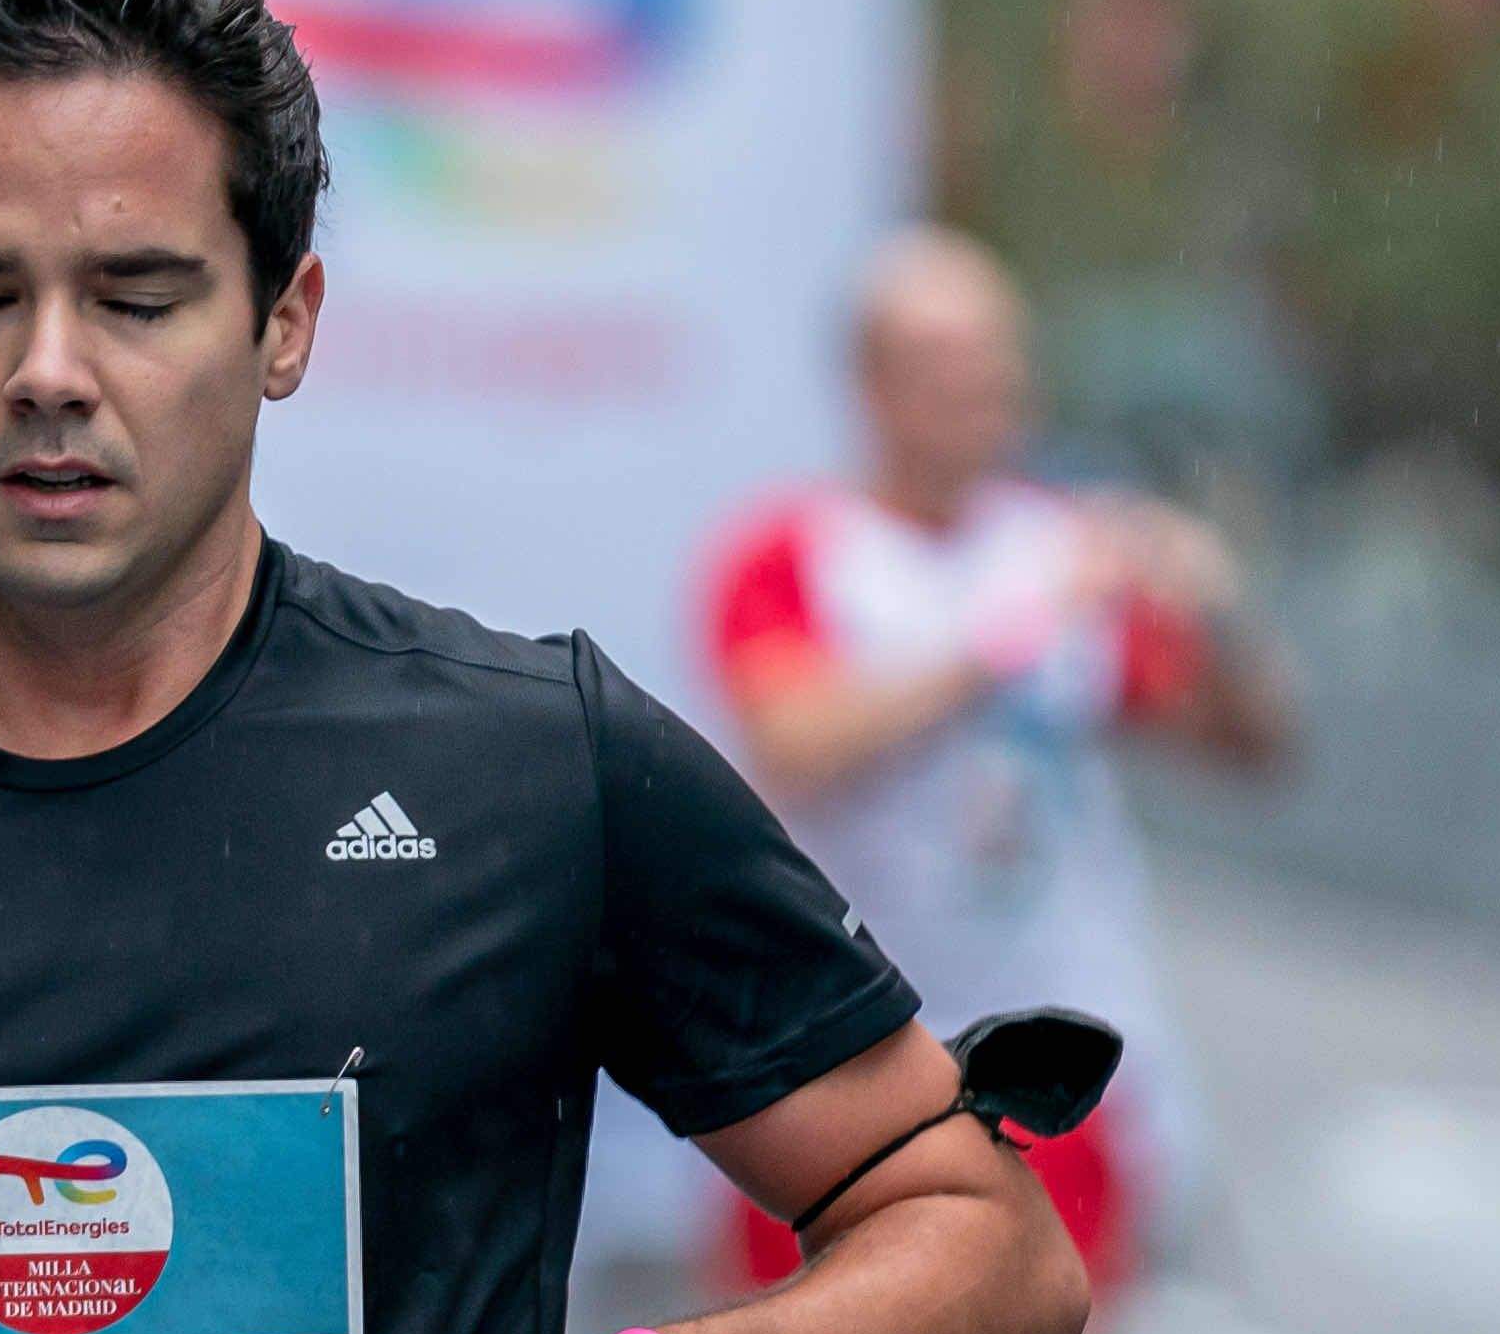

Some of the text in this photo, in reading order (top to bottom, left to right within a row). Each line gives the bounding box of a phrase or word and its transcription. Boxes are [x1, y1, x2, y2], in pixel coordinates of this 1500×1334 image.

[325, 833, 437, 861] adidas
[28, 1259, 91, 1276] MILLA
[4, 1298, 118, 1318] DE MADRID
